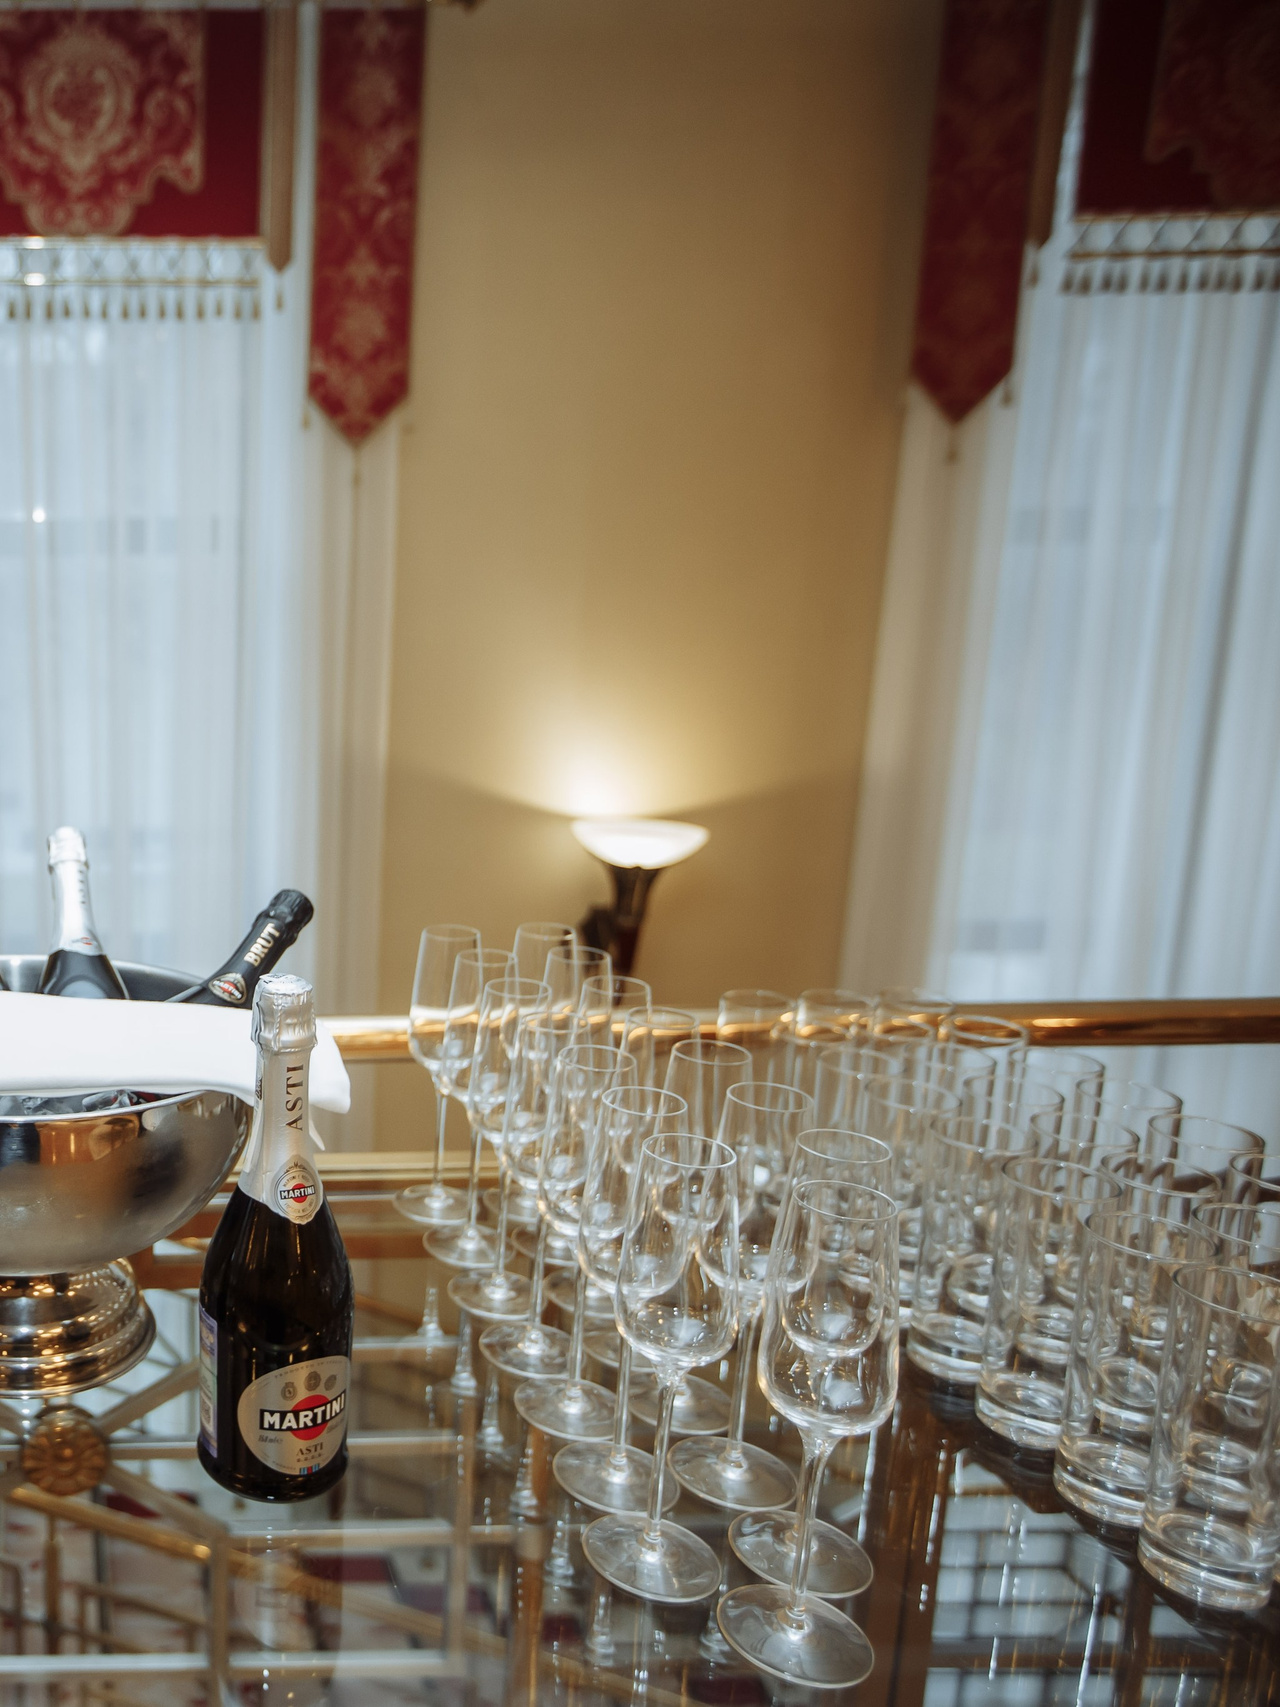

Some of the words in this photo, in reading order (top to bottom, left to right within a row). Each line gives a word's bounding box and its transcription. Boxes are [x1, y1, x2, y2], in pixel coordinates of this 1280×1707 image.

[244, 922, 281, 967] BRUT
[286, 1063, 304, 1131] ASTI
[281, 1186, 315, 1199] MARTINI
[263, 1393, 346, 1430] MARTINI
[295, 1441, 324, 1456] ASTI
